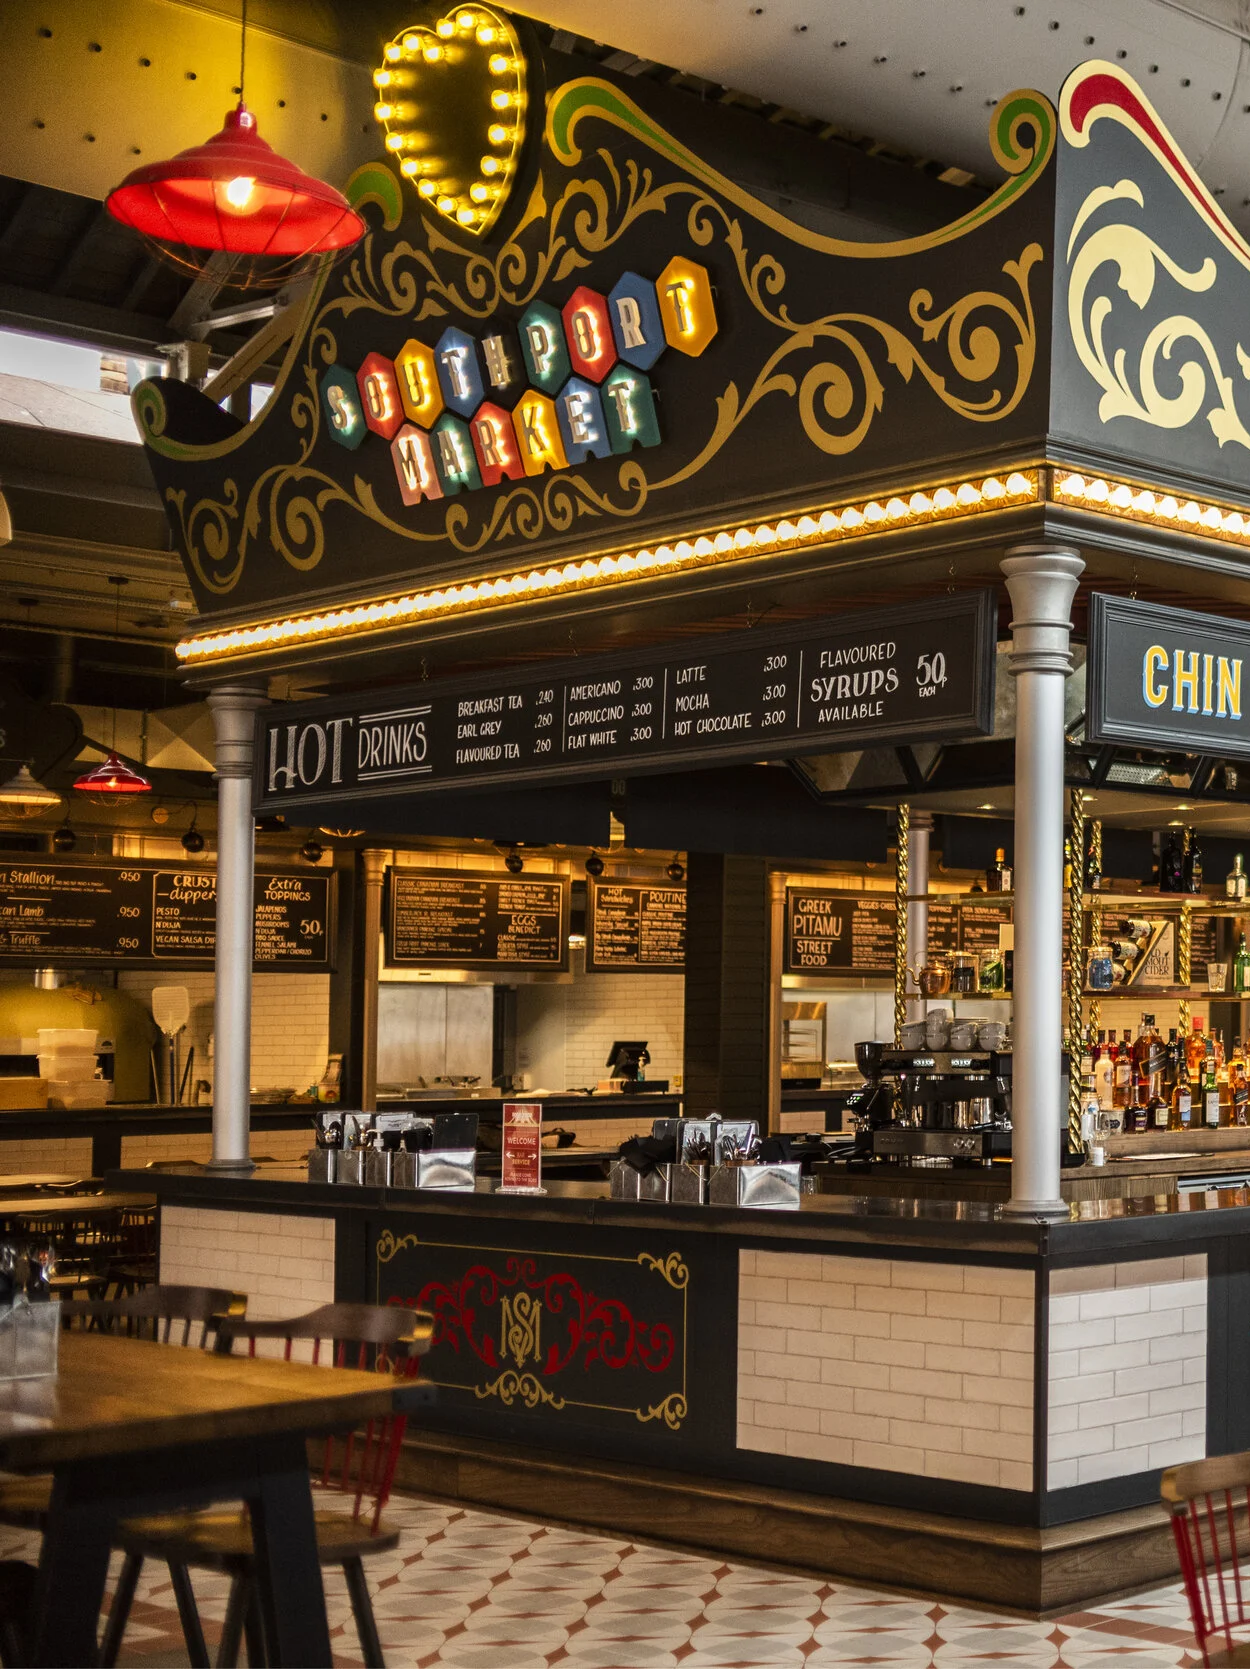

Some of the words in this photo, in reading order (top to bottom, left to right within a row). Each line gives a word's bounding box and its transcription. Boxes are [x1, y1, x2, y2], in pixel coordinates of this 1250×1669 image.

[326, 278, 695, 430] SOUTHPORT
[397, 381, 637, 489] MARKET
[820, 641, 896, 668] FLAVOURED
[676, 665, 707, 685] LATTE
[810, 667, 899, 703] SYRUPS
[1142, 645, 1243, 720] CHIN
[569, 680, 621, 701] AMERICANO
[918, 686, 936, 697] EACH
[457, 697, 505, 718] BREAKFAST
[508, 695, 523, 710] TEA
[675, 693, 710, 713] MOCHA
[818, 701, 884, 723] AVAILABLE
[568, 705, 624, 727] CAPPUCCINO
[674, 720, 693, 736] HOT
[696, 712, 752, 734] CHOCOLATE
[457, 723, 477, 739] EARL
[479, 720, 502, 736] GREY
[357, 721, 428, 769] DRINKS
[568, 733, 587, 750] FLAT
[589, 730, 617, 746] WHITE
[268, 718, 353, 792] HOT
[456, 744, 502, 764] FLAVOURED
[503, 743, 520, 759] TEA
[9, 870, 56, 885] Stallion
[268, 877, 302, 891] Extra
[264, 890, 311, 901] TOPPINGS
[19, 904, 45, 917] Lamb
[156, 907, 180, 916] PESTO
[798, 899, 832, 914] GREEK
[507, 925, 541, 934] BENEDICT
[511, 914, 537, 926] EGGS
[793, 914, 843, 937] PITAMU
[10, 934, 41, 945] Truffle
[796, 940, 833, 954] STREET
[800, 954, 828, 966] FOOD
[1144, 965, 1170, 975] CIDER
[507, 1136, 537, 1145] WELCOME
